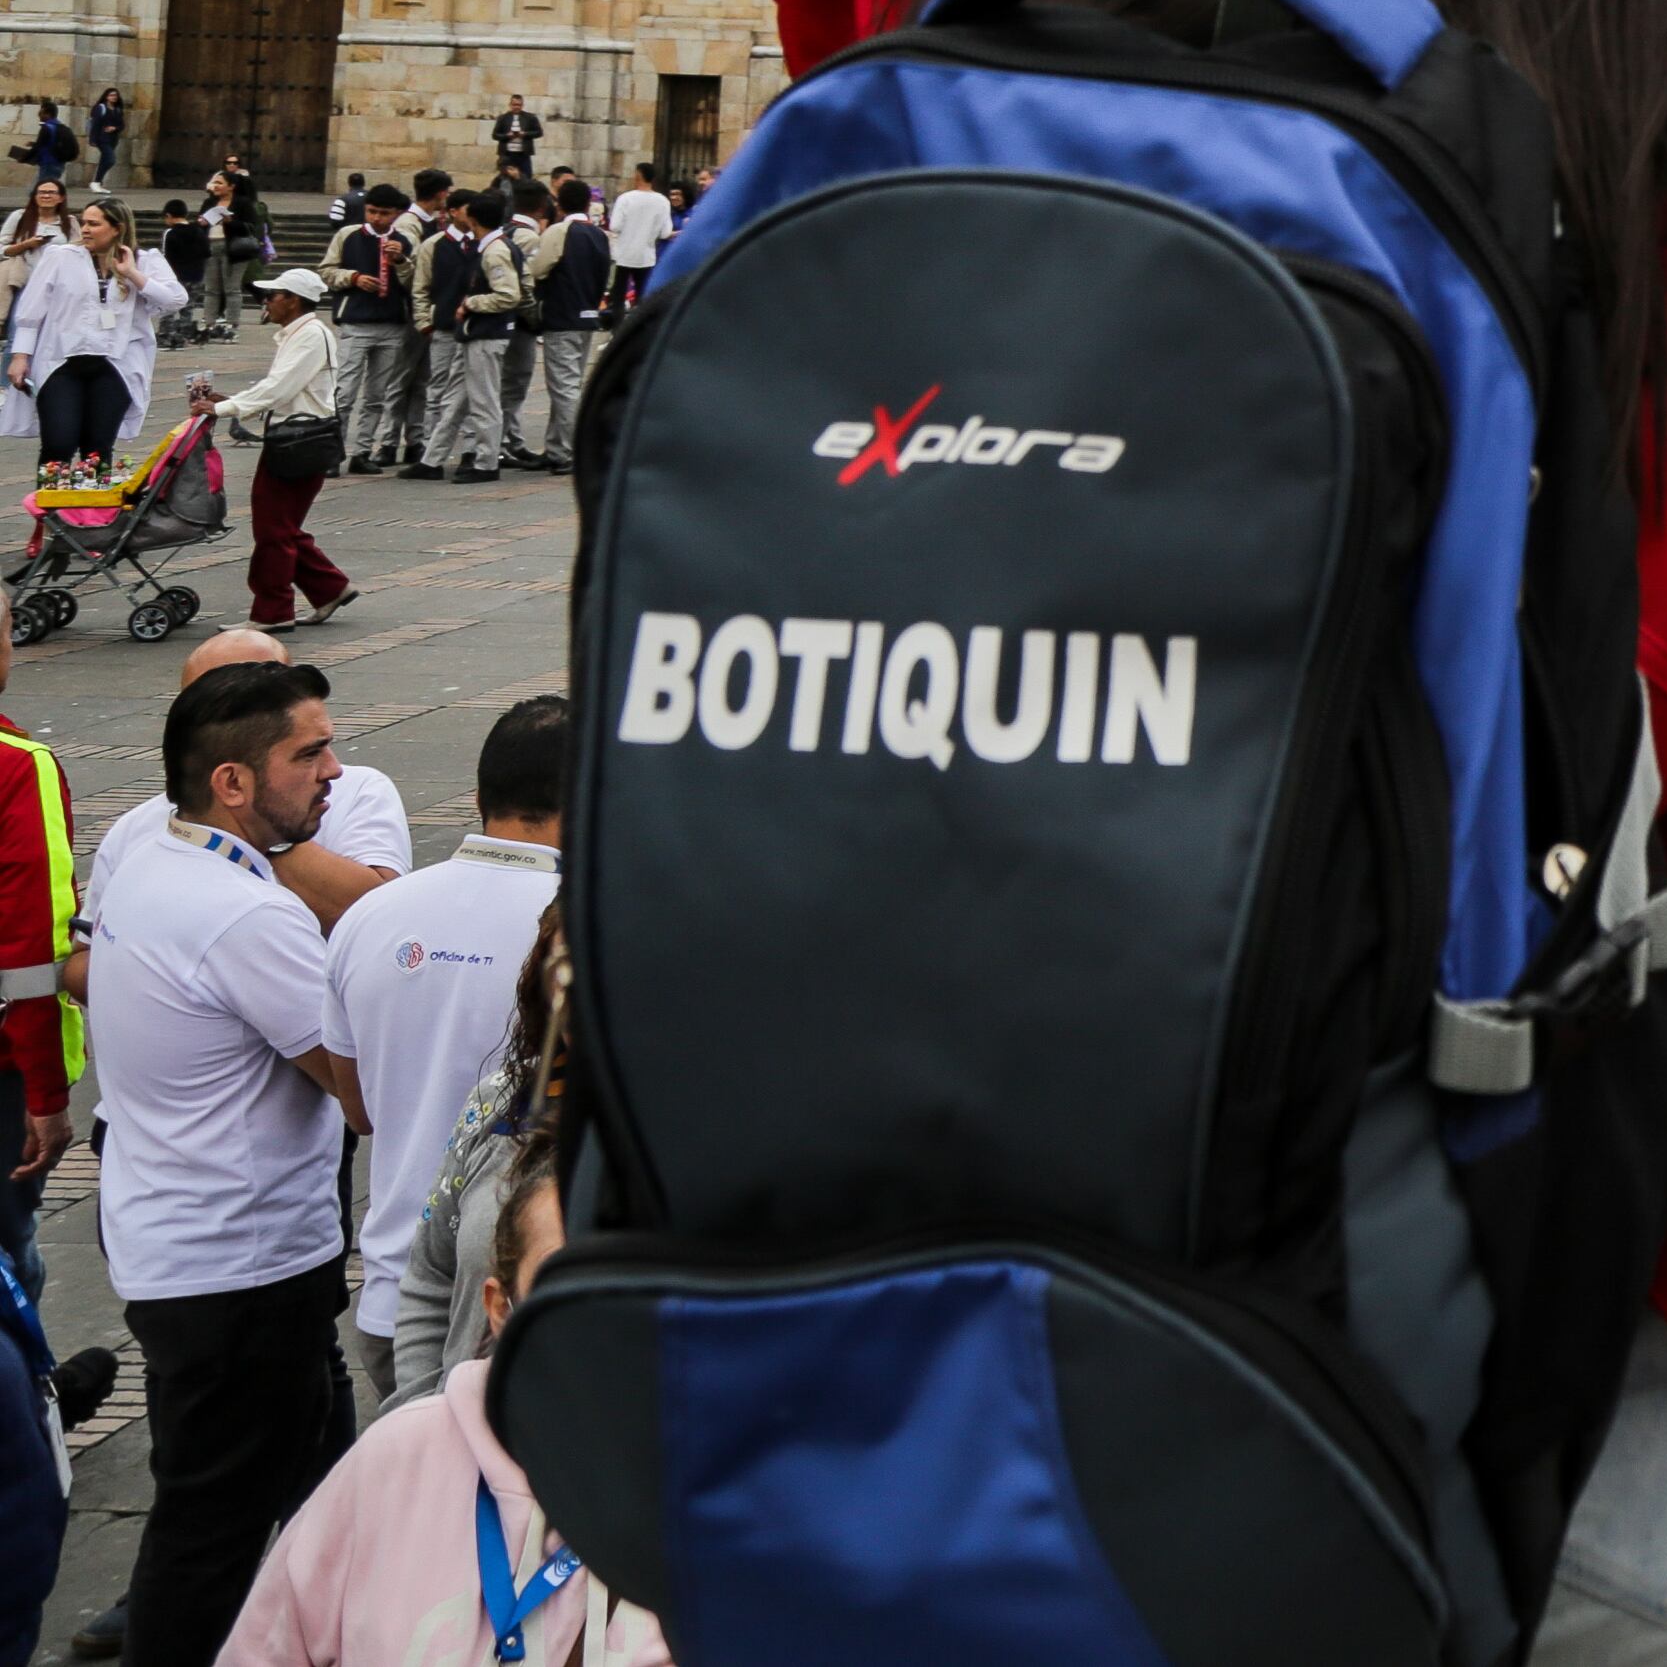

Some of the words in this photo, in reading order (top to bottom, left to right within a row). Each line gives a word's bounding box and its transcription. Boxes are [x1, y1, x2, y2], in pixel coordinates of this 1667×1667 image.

[617, 611, 1197, 771] BOTIQUIN
[430, 950, 465, 963] Oficina
[467, 953, 481, 965] de
